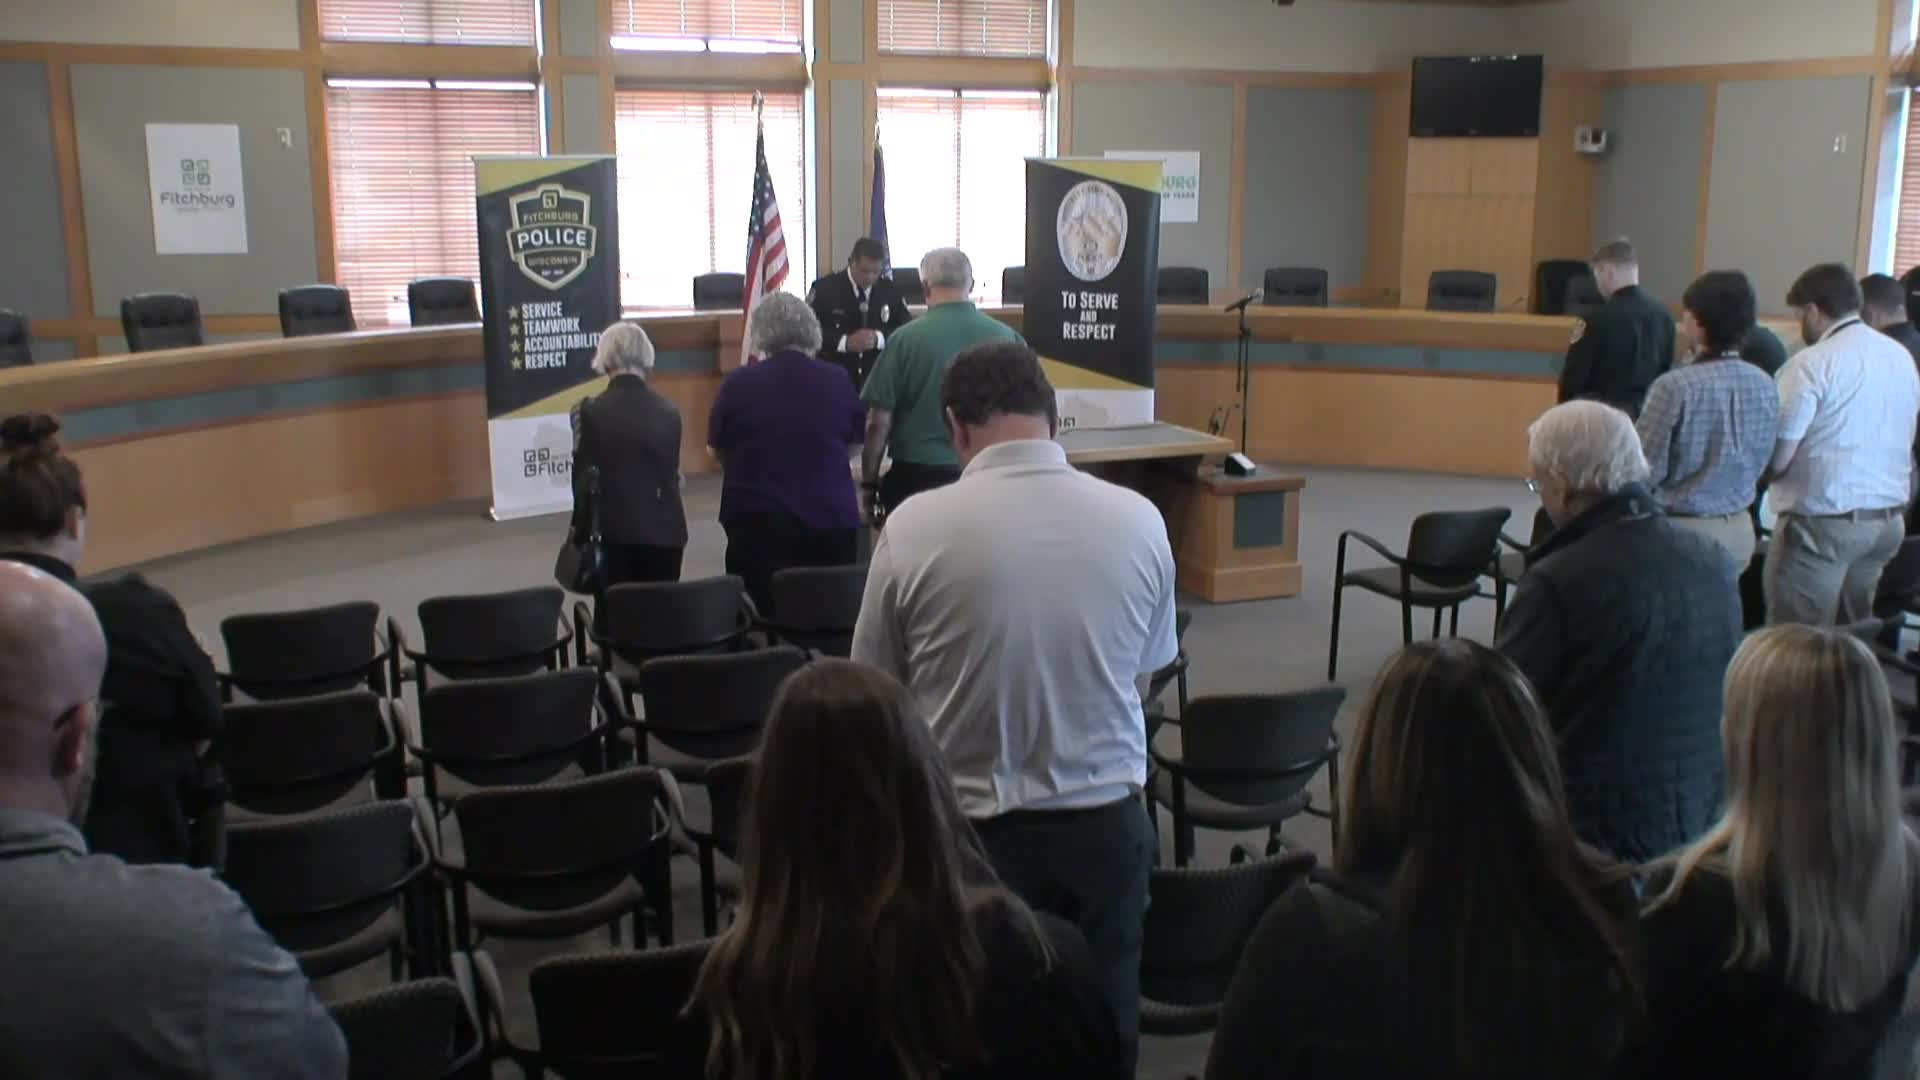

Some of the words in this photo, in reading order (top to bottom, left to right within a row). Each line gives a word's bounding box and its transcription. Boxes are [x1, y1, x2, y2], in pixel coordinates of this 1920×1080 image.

[160, 192, 235, 208] Fitchburg
[517, 228, 587, 249] POLICE
[1061, 291, 1076, 309] TO
[1080, 291, 1119, 310] SERVE
[522, 301, 563, 319] SERVICE
[1080, 310, 1097, 322] AND
[523, 317, 581, 336] TEAMWORK
[1063, 321, 1116, 340] RESPECT
[525, 351, 567, 369] RESPECT
[538, 460, 573, 476] Fitch
